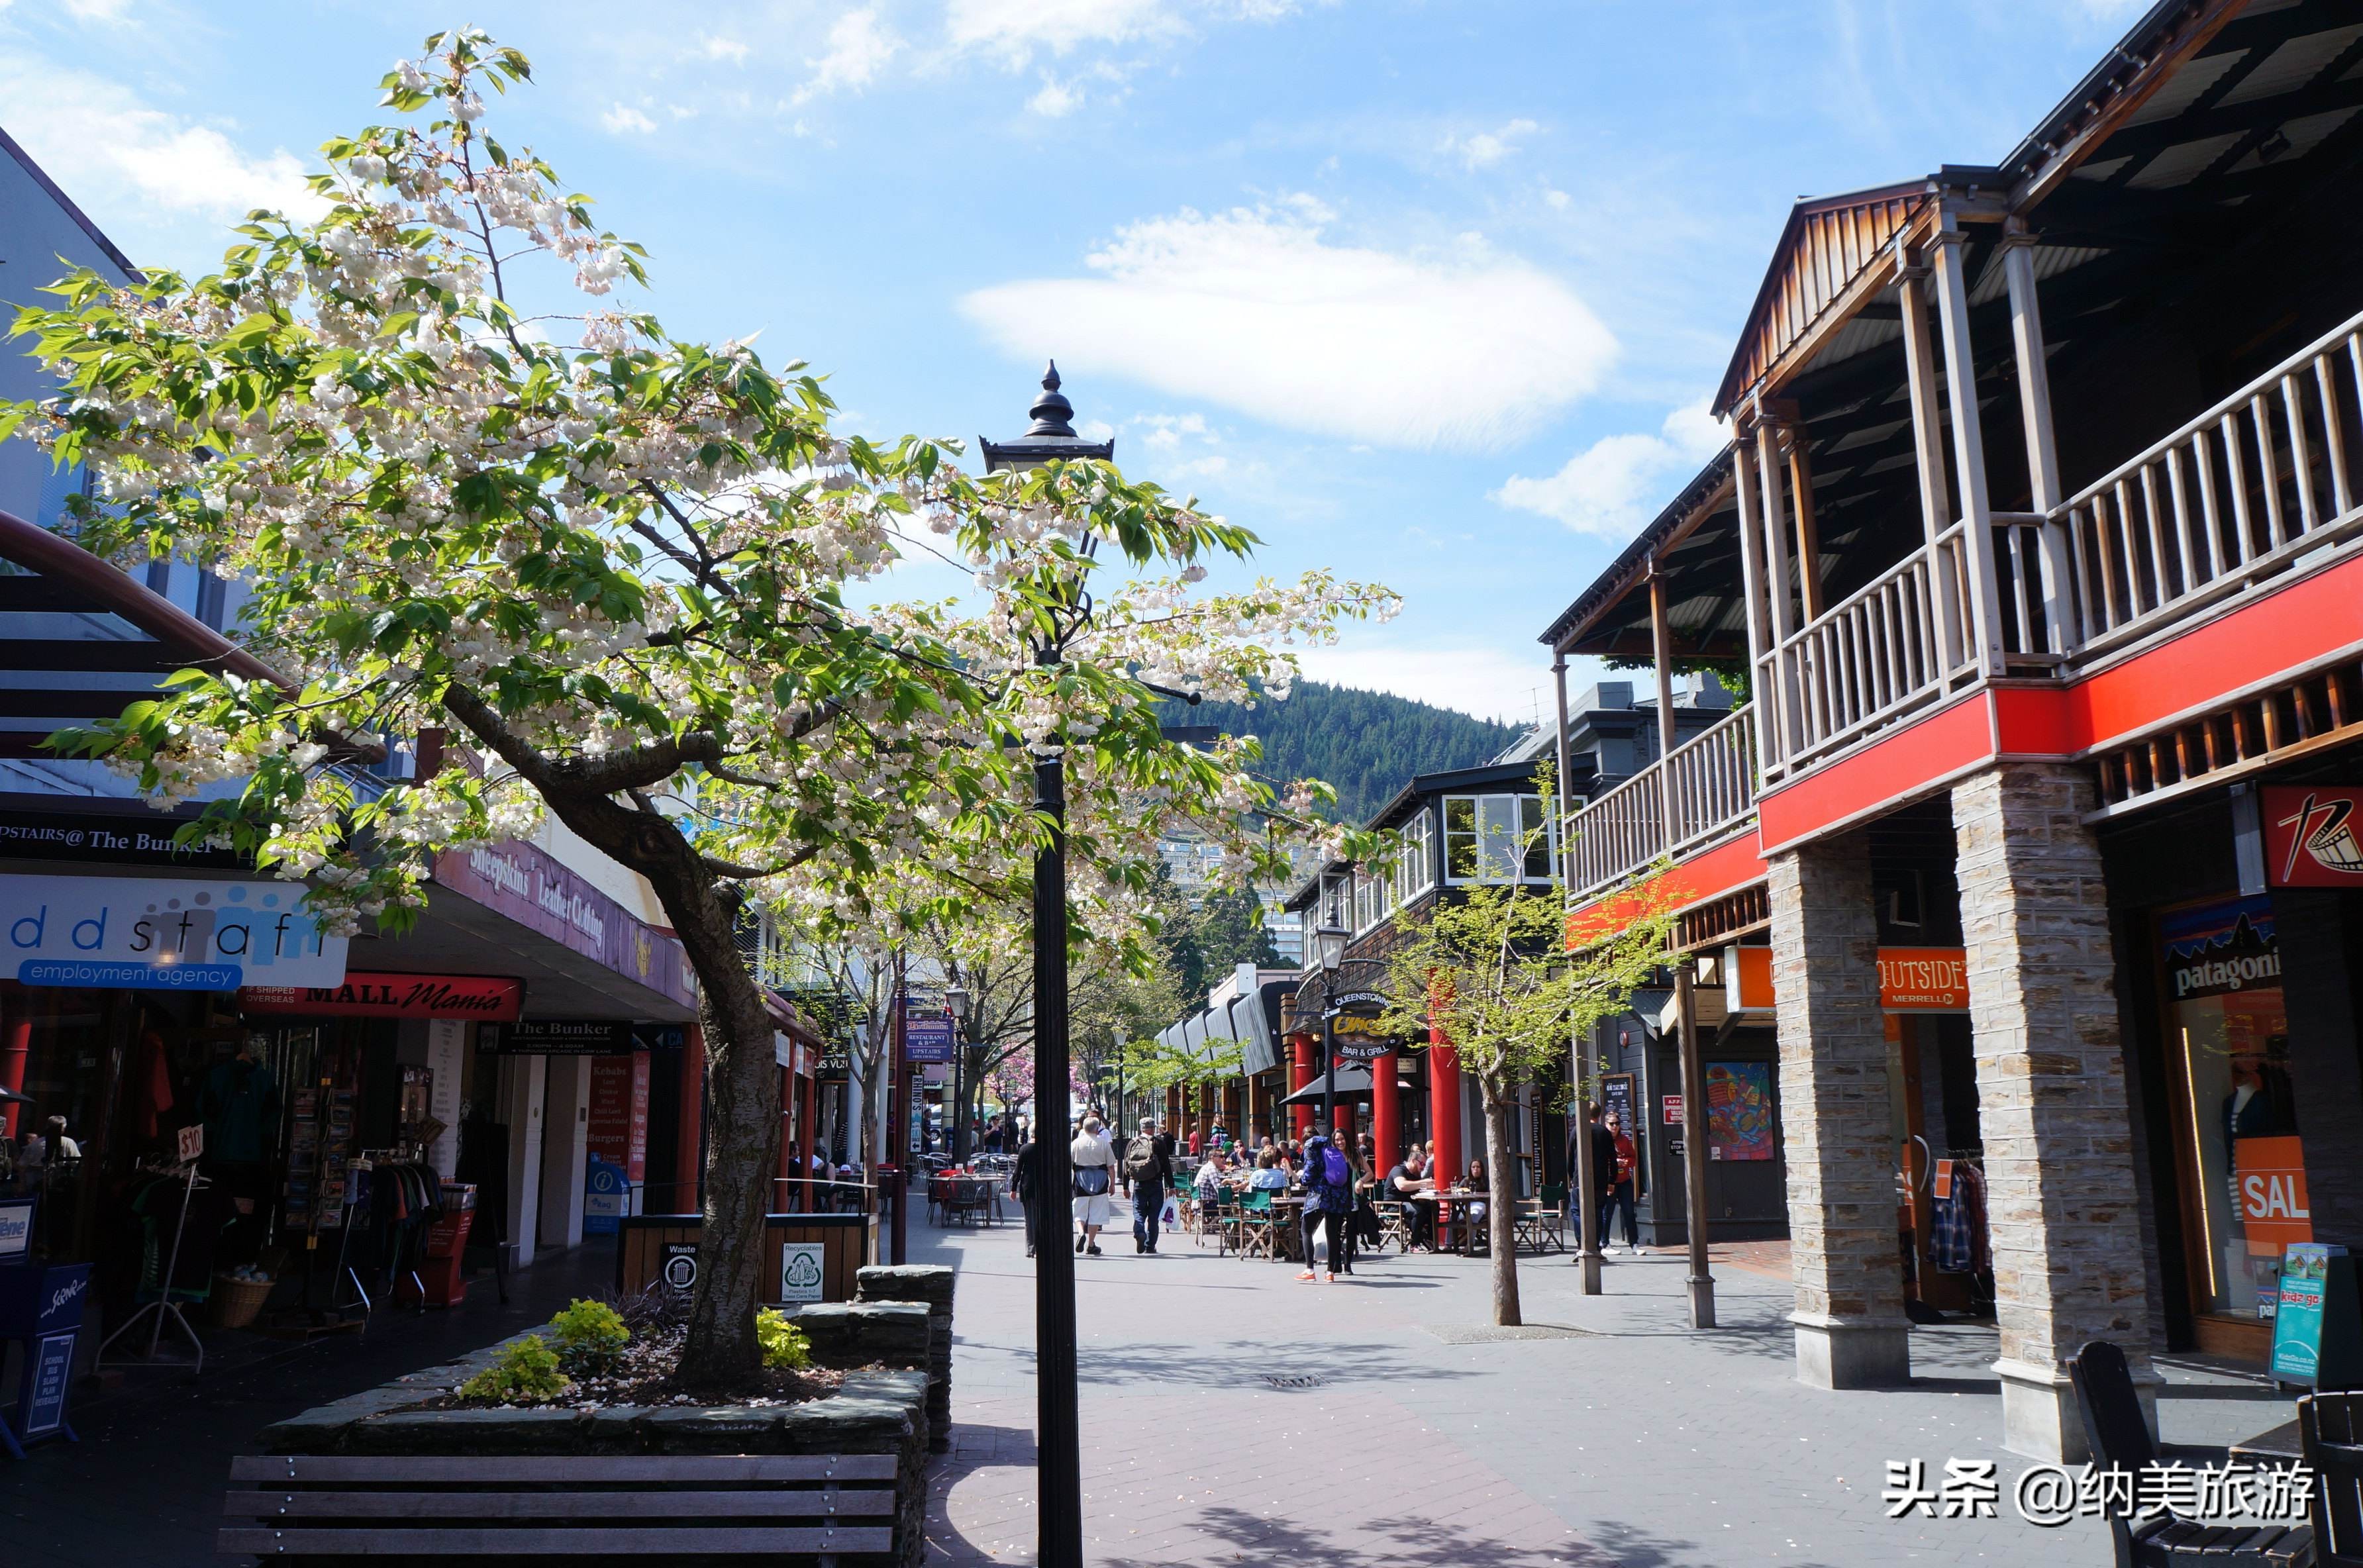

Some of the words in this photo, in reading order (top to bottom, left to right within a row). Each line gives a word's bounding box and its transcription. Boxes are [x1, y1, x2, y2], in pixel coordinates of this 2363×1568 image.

[88, 831, 128, 850] The
[538, 872, 572, 920] Leather
[572, 894, 603, 948] Clothing
[32, 963, 152, 983] employment
[158, 967, 232, 985] agency
[256, 986, 295, 995] SHIPPED
[305, 983, 398, 1006] MALL
[400, 982, 505, 1011] Mania
[246, 995, 295, 1004] OVERSEAS
[512, 1022, 544, 1034] The
[550, 1022, 612, 1034] Bunker
[1342, 1045, 1358, 1056] BAR
[1366, 1044, 1389, 1056] GRILL
[593, 1066, 627, 1076] Kebabs
[913, 1077, 923, 1111] RHINO'S
[181, 1129, 201, 1157] $10
[588, 1133, 625, 1144] Burgers
[669, 1245, 696, 1253] Waste
[2280, 1290, 2305, 1304] kidz
[2306, 1294, 2320, 1307] go
